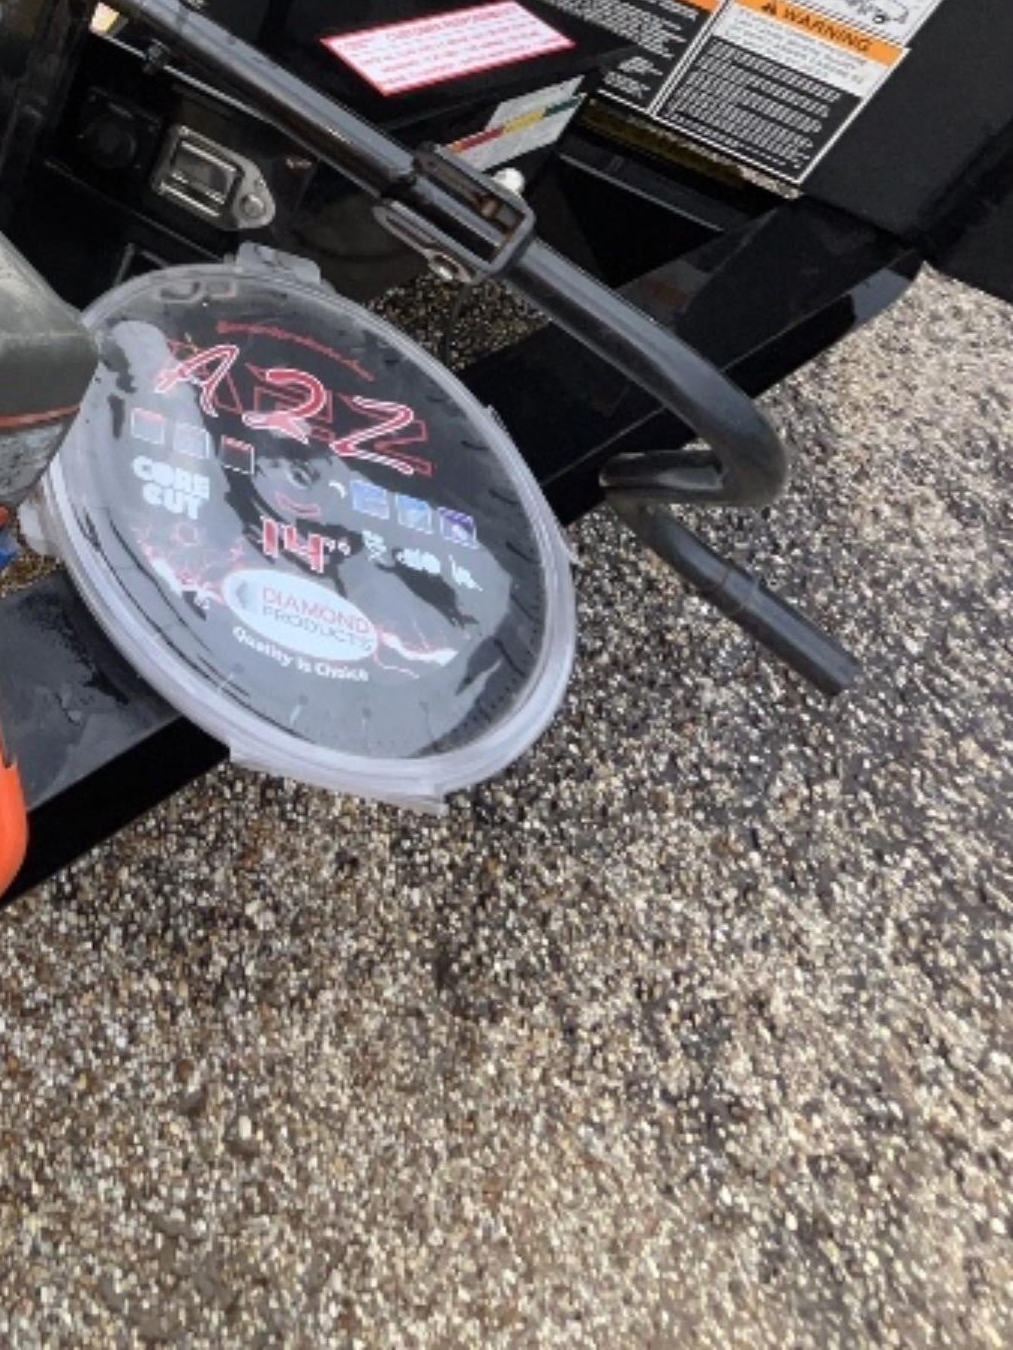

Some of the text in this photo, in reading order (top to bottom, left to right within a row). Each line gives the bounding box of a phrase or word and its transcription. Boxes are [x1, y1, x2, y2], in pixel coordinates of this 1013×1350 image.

[783, 6, 872, 52] WARNING
[132, 454, 211, 500] CORE
[142, 481, 208, 521] CUT
[262, 586, 370, 634] DIAMOND
[262, 604, 374, 652] PRODUCTS
[231, 625, 294, 668] Quality
[314, 662, 370, 682] Choice
